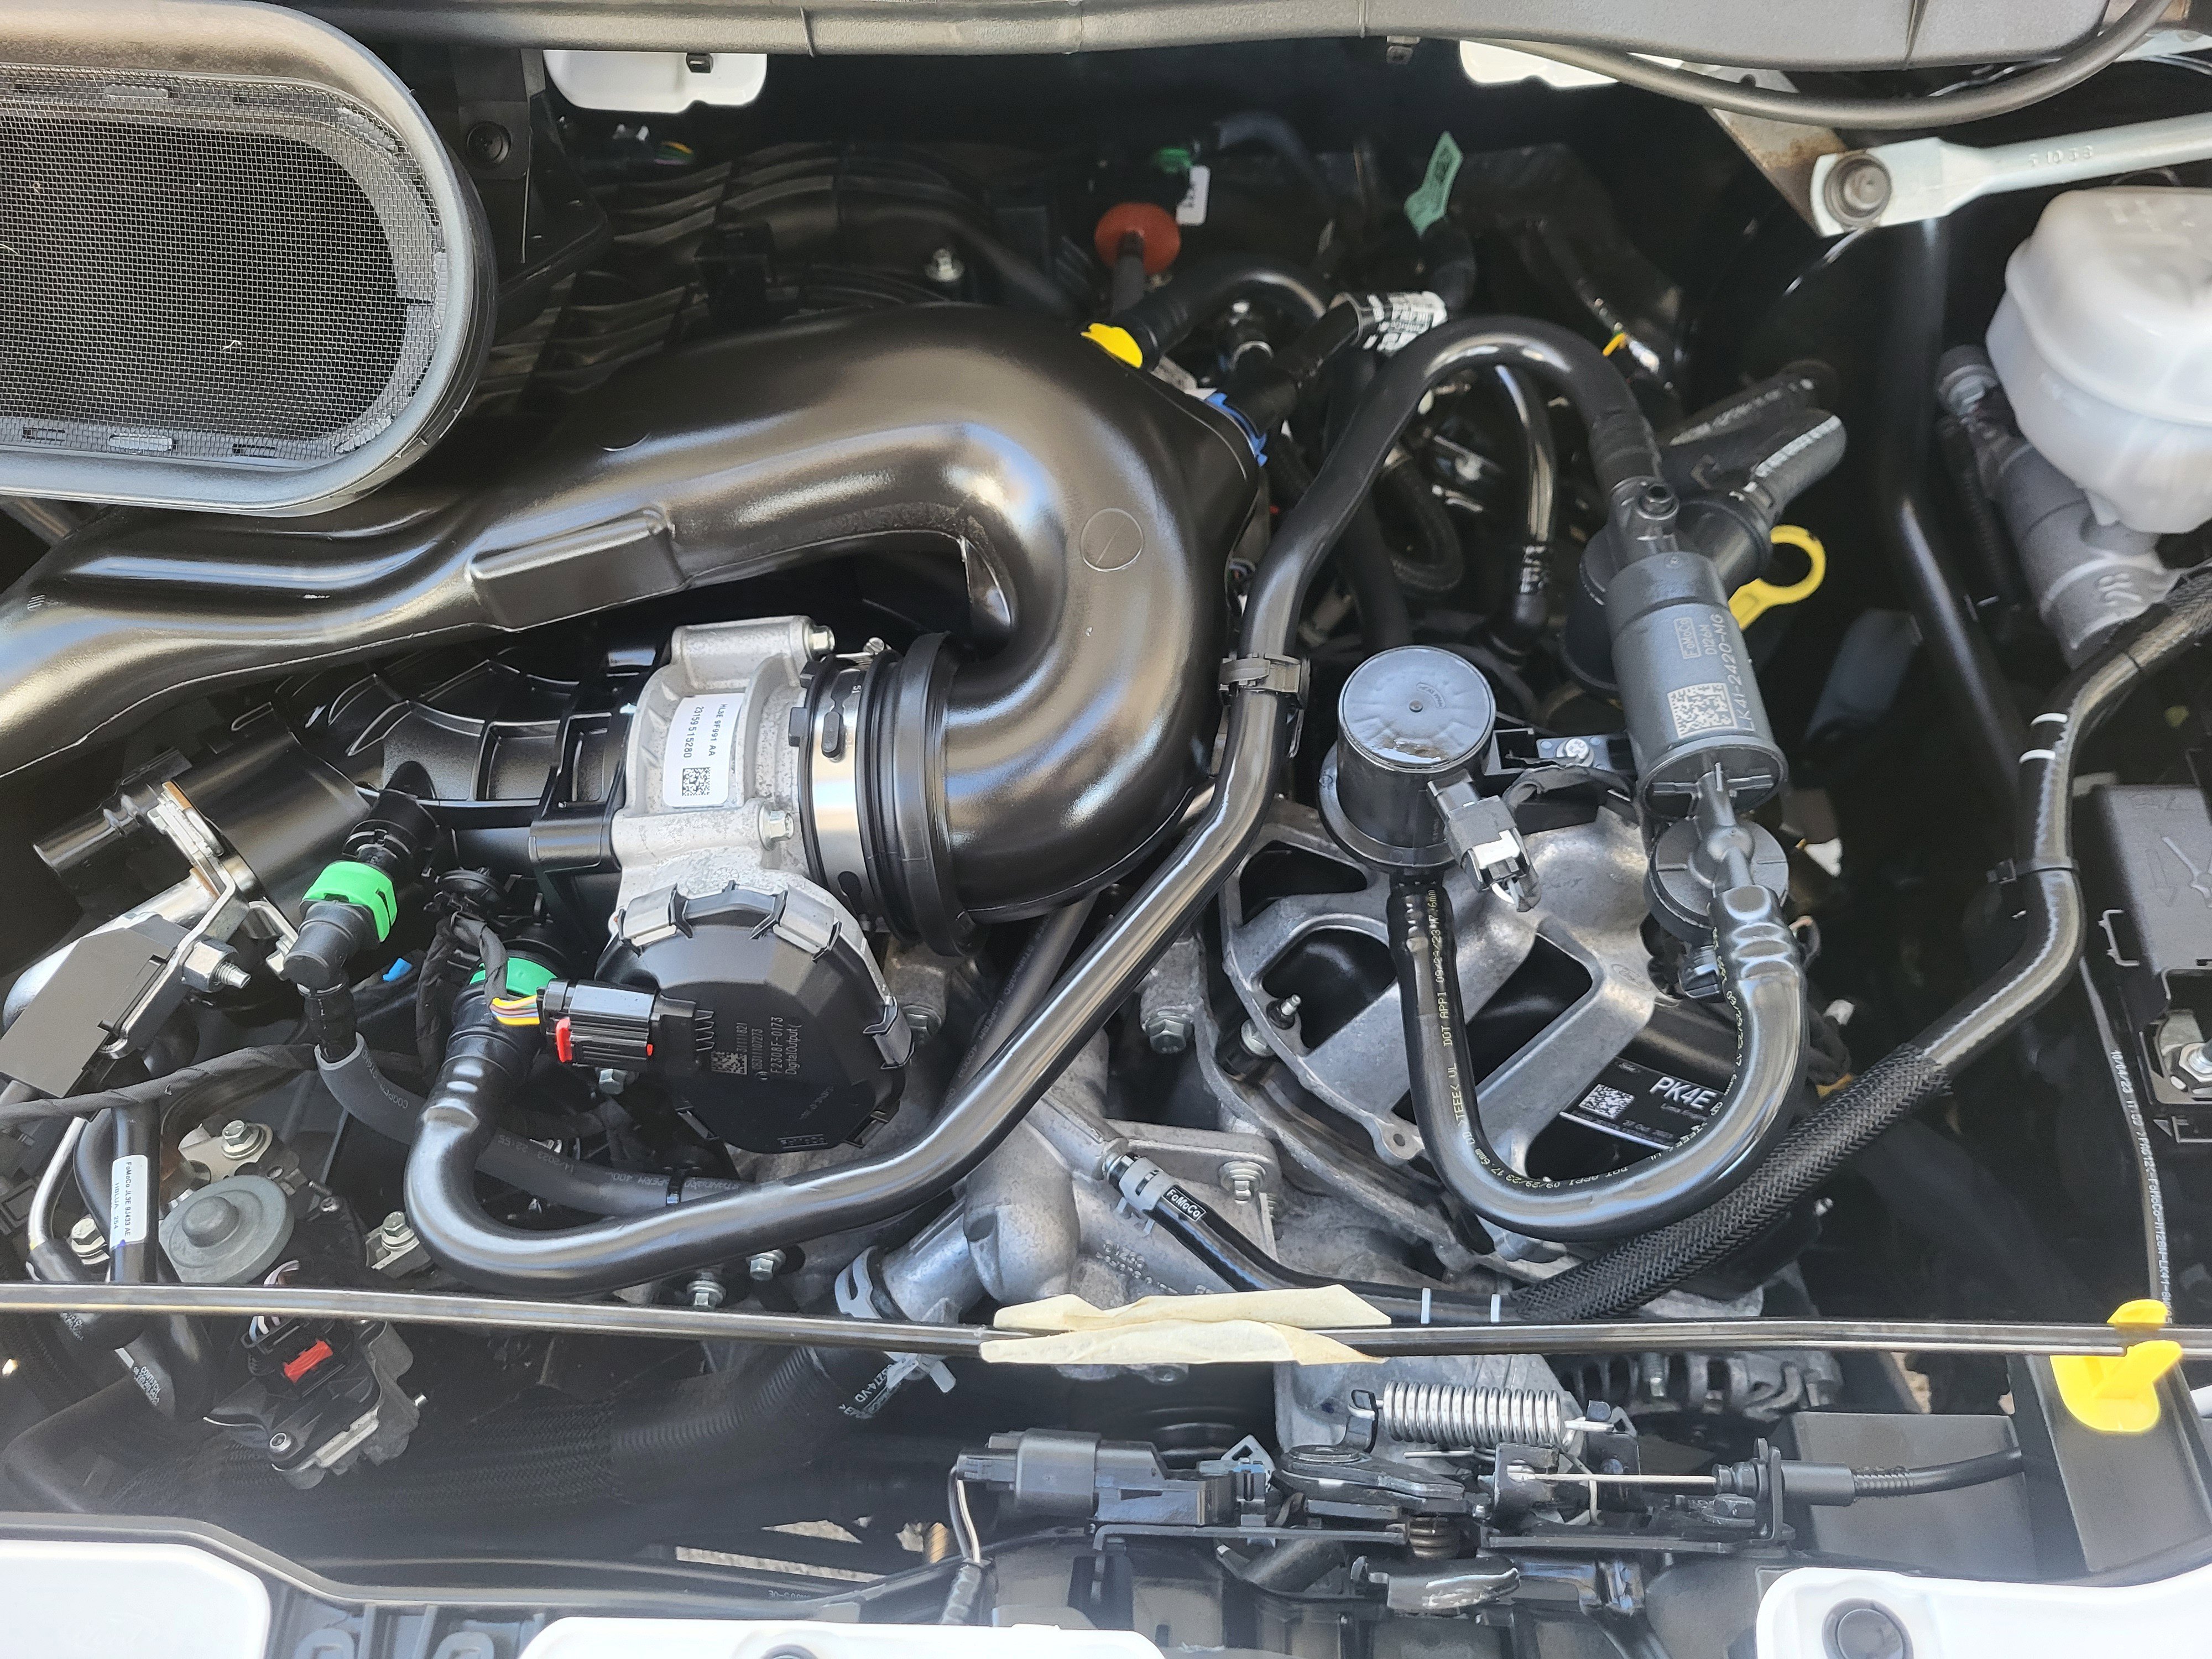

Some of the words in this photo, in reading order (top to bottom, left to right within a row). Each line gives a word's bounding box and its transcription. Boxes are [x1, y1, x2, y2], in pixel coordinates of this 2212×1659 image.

[1678, 619, 1697, 656] FoMoCo
[716, 704, 728, 718] HL3E
[711, 720, 721, 740] 9F991
[708, 745, 716, 756] AA
[770, 1016, 783, 1073] F2308F-0173
[1650, 1076, 1717, 1110] PK4E
[1166, 1188, 1201, 1218] FoMoCo
